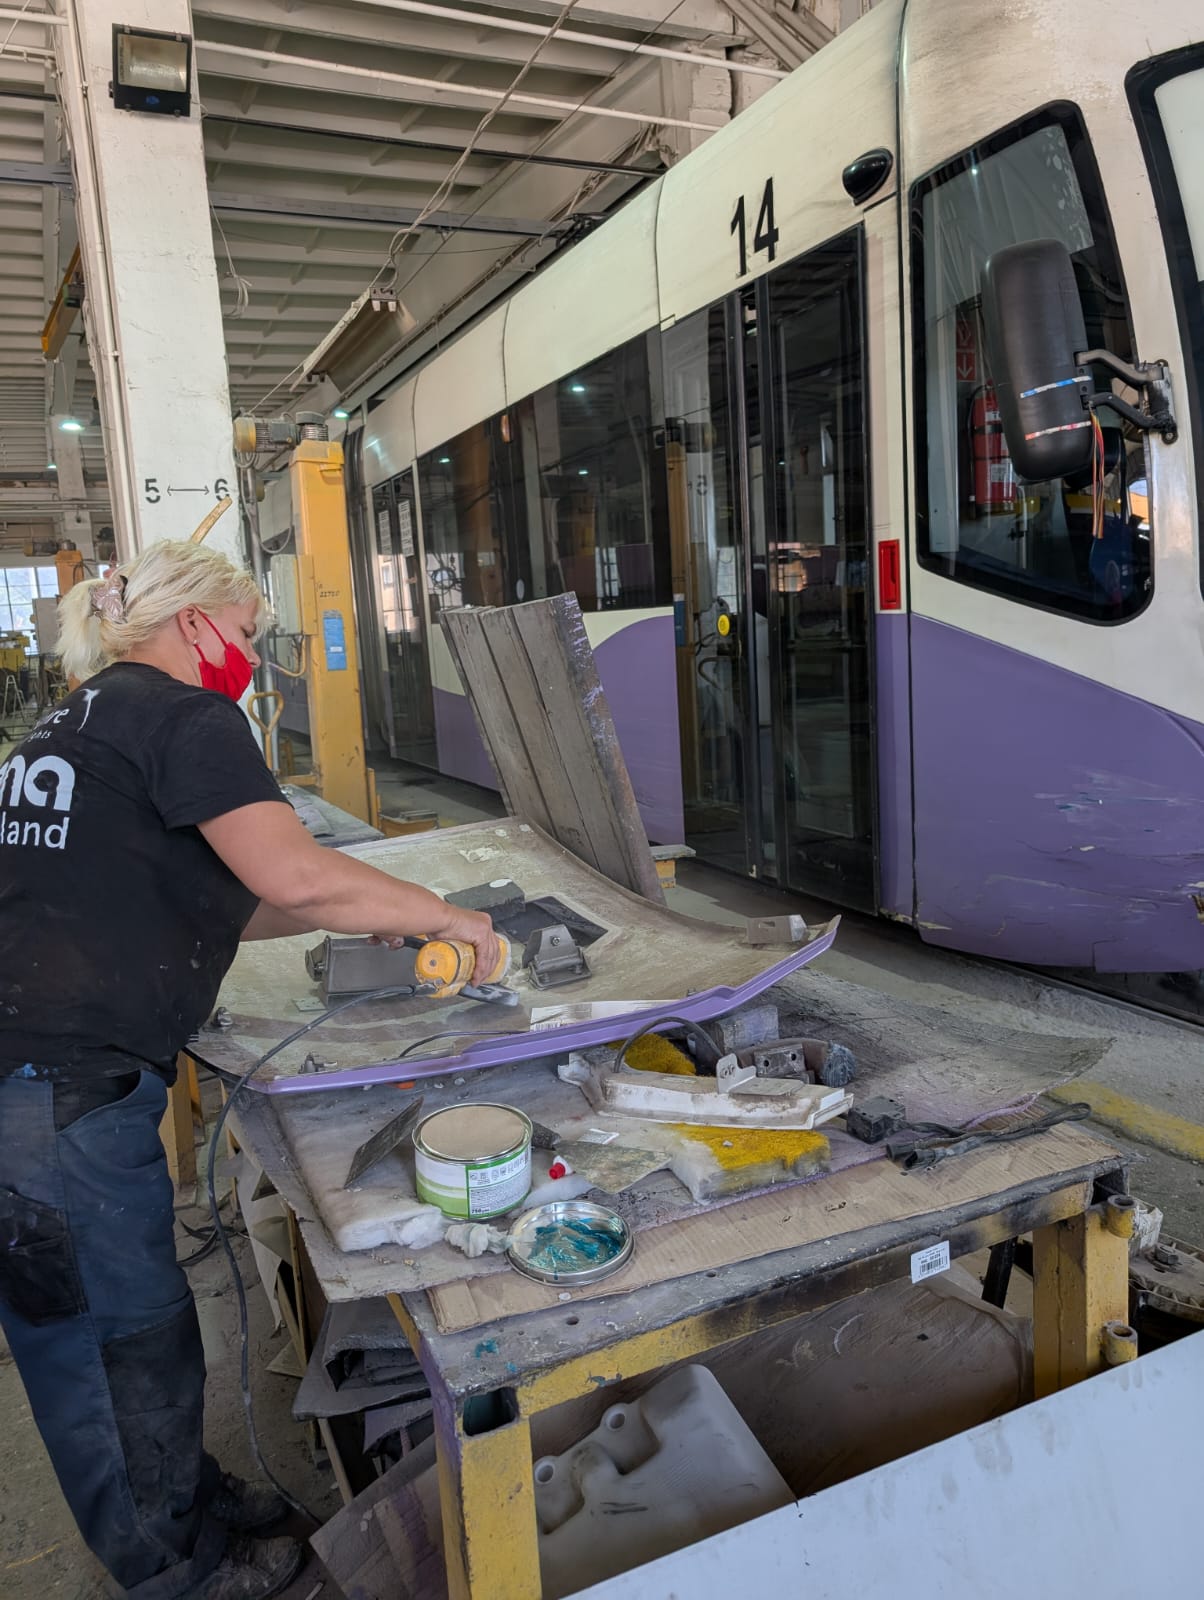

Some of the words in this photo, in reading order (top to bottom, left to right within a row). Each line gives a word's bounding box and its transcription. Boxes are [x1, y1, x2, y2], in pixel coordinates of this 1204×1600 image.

[730, 176, 779, 278] 14
[145, 478, 161, 504] 5
[214, 478, 230, 502] 6
